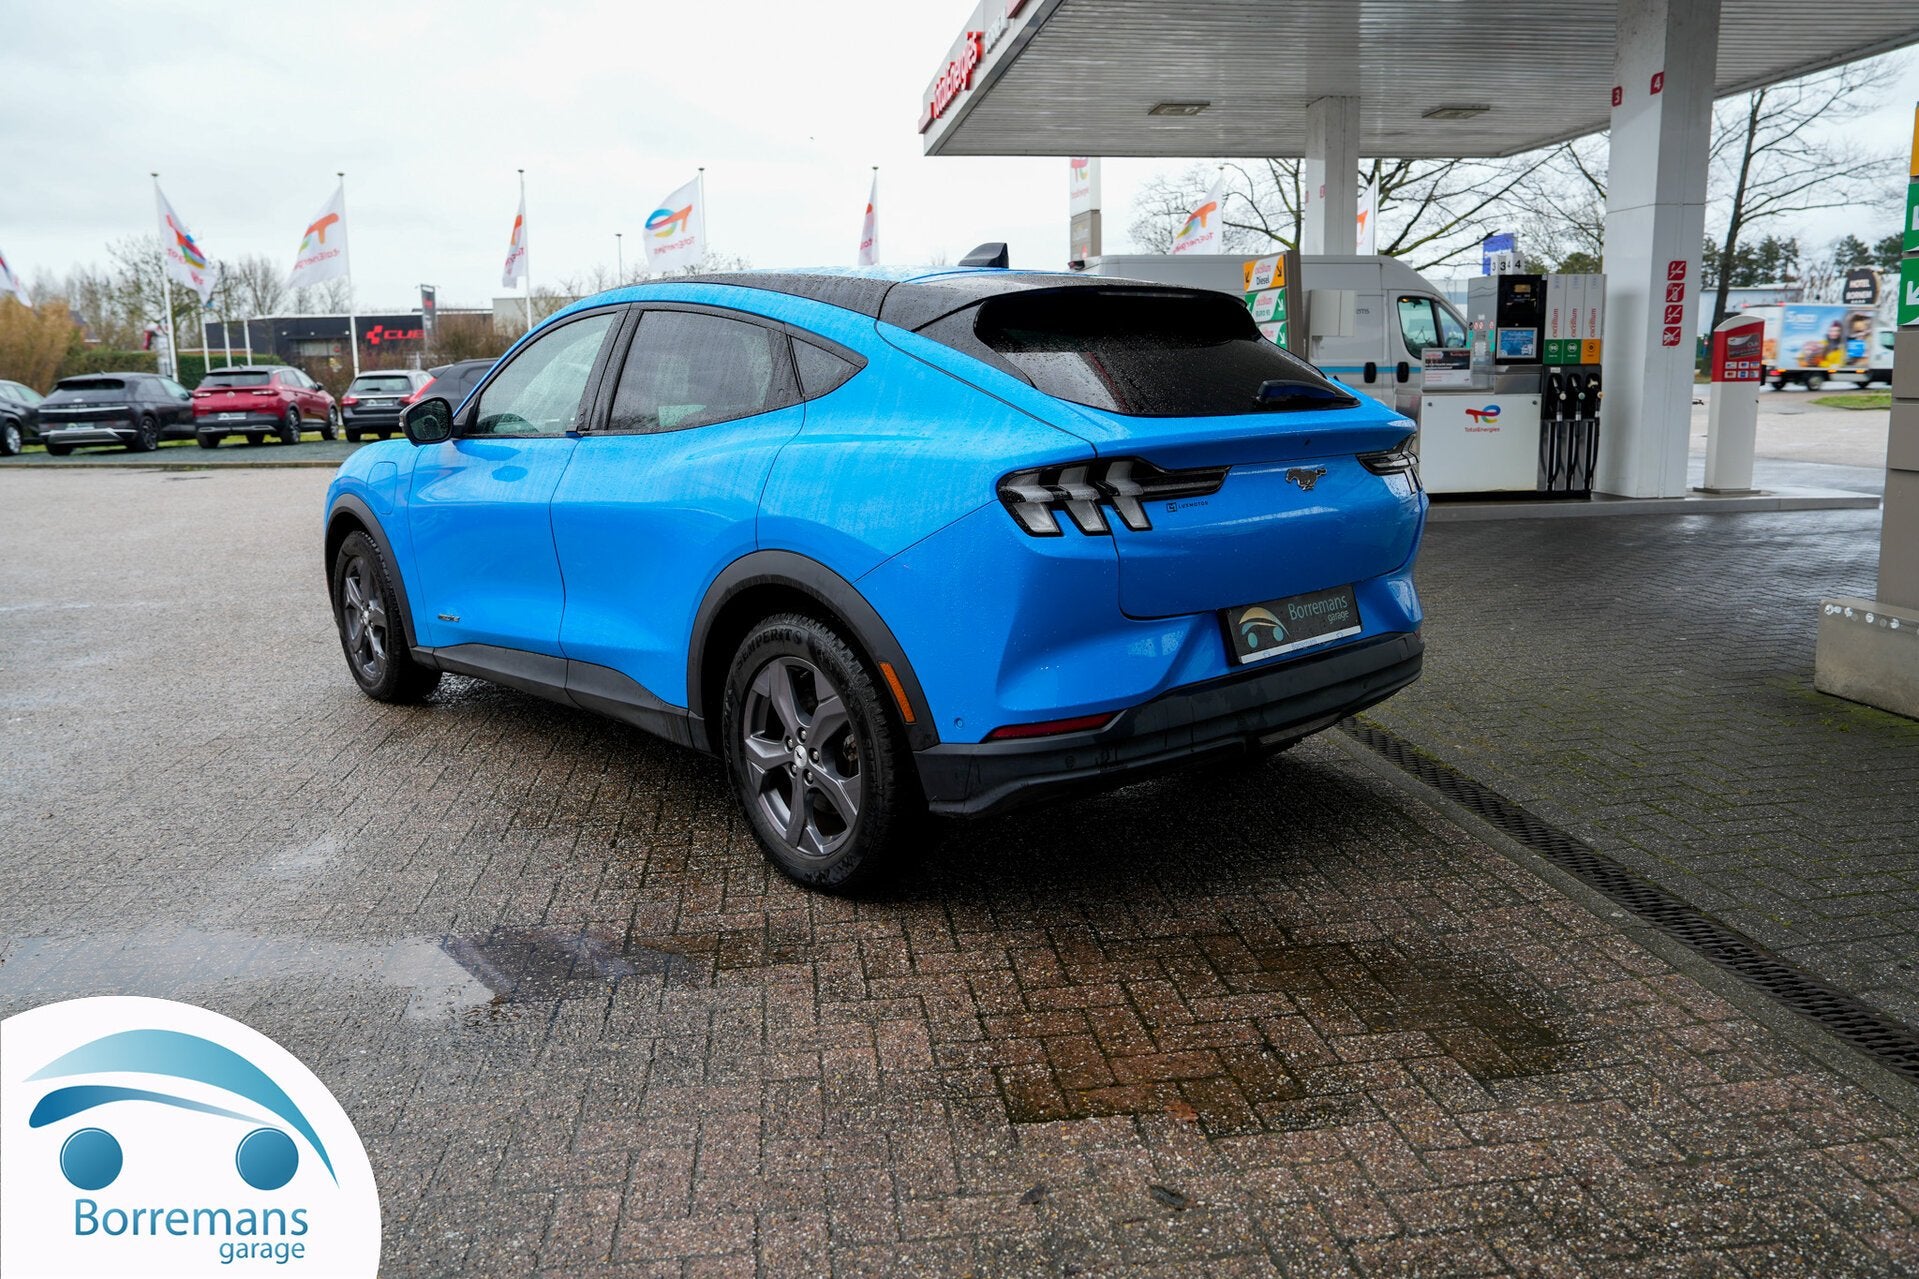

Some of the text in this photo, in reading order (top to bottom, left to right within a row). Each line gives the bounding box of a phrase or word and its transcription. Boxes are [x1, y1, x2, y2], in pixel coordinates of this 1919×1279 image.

[1500, 262, 1506, 271] 3
[1515, 260, 1521, 269] 4
[1256, 274, 1270, 286] Diesel
[1849, 279, 1871, 288] HOTEL
[1288, 595, 1348, 621] Borremans
[1327, 609, 1350, 625] garage
